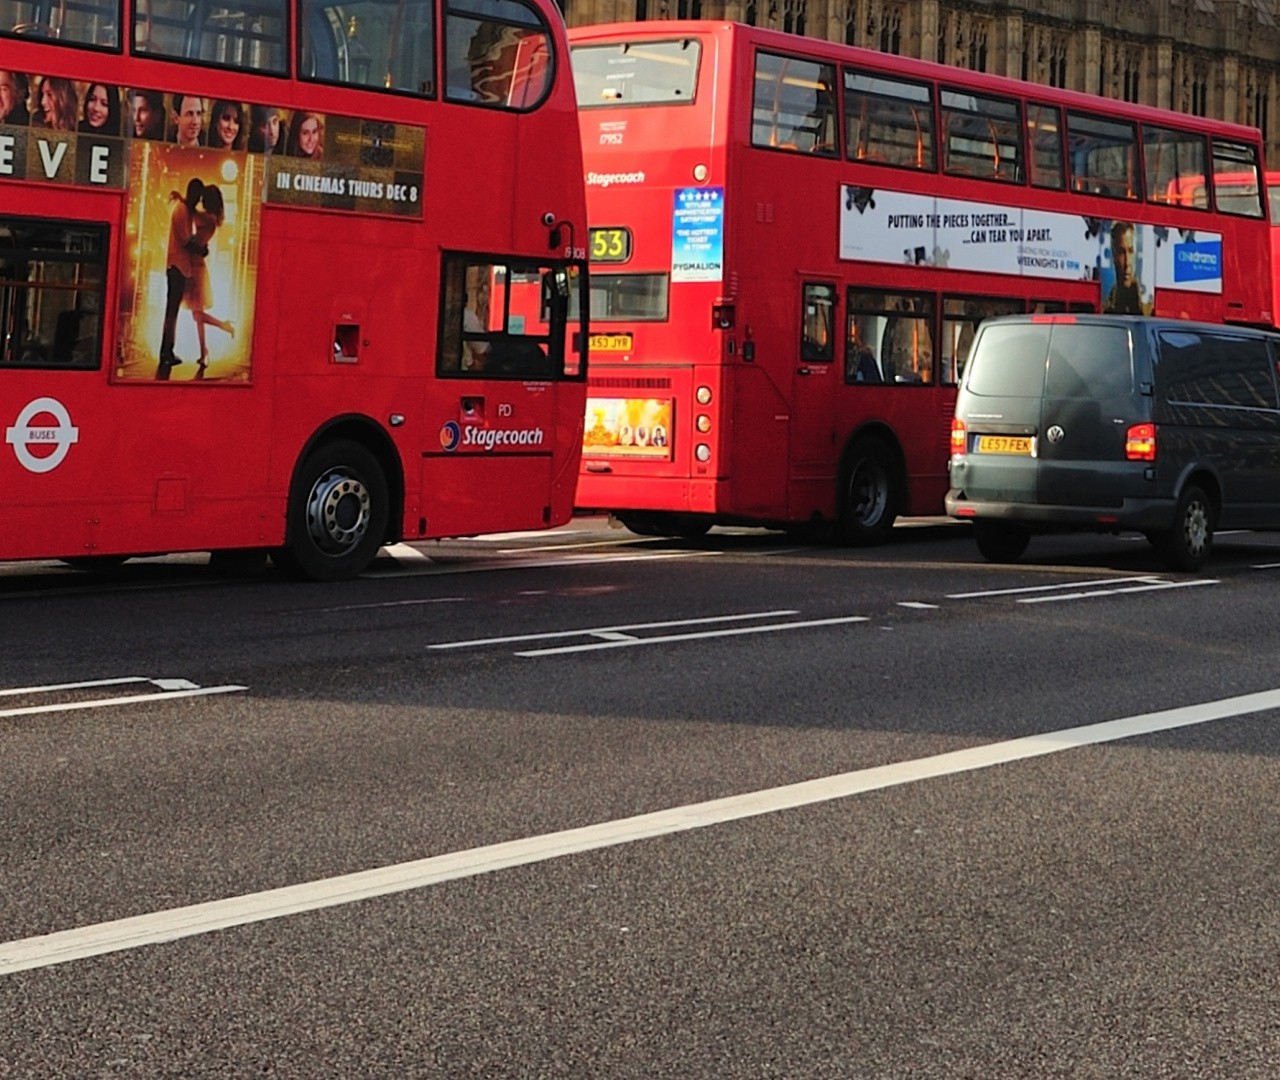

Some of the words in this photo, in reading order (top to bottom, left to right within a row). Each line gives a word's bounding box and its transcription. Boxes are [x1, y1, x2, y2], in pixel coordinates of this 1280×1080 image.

[587, 172, 645, 187] Stagecoach
[276, 172, 291, 189] IN
[293, 174, 345, 195] CINEMAS
[348, 180, 383, 199] THURS
[386, 184, 407, 201] DEC
[409, 187, 418, 203] 8
[888, 215, 923, 228] PUTTING
[926, 214, 940, 228] THE
[943, 214, 969, 227] PIECES
[989, 230, 1007, 243] TEAR
[1009, 229, 1024, 242] YOU
[1027, 228, 1052, 241] APART.
[593, 230, 622, 256] 53
[1017, 256, 1059, 269] WEEKNIGHTS
[498, 404, 513, 417] PD
[29, 430, 56, 440] BUSES
[463, 426, 543, 450] Stagecoach
[981, 437, 1008, 450] LE57
[1010, 439, 1030, 451] FEK
